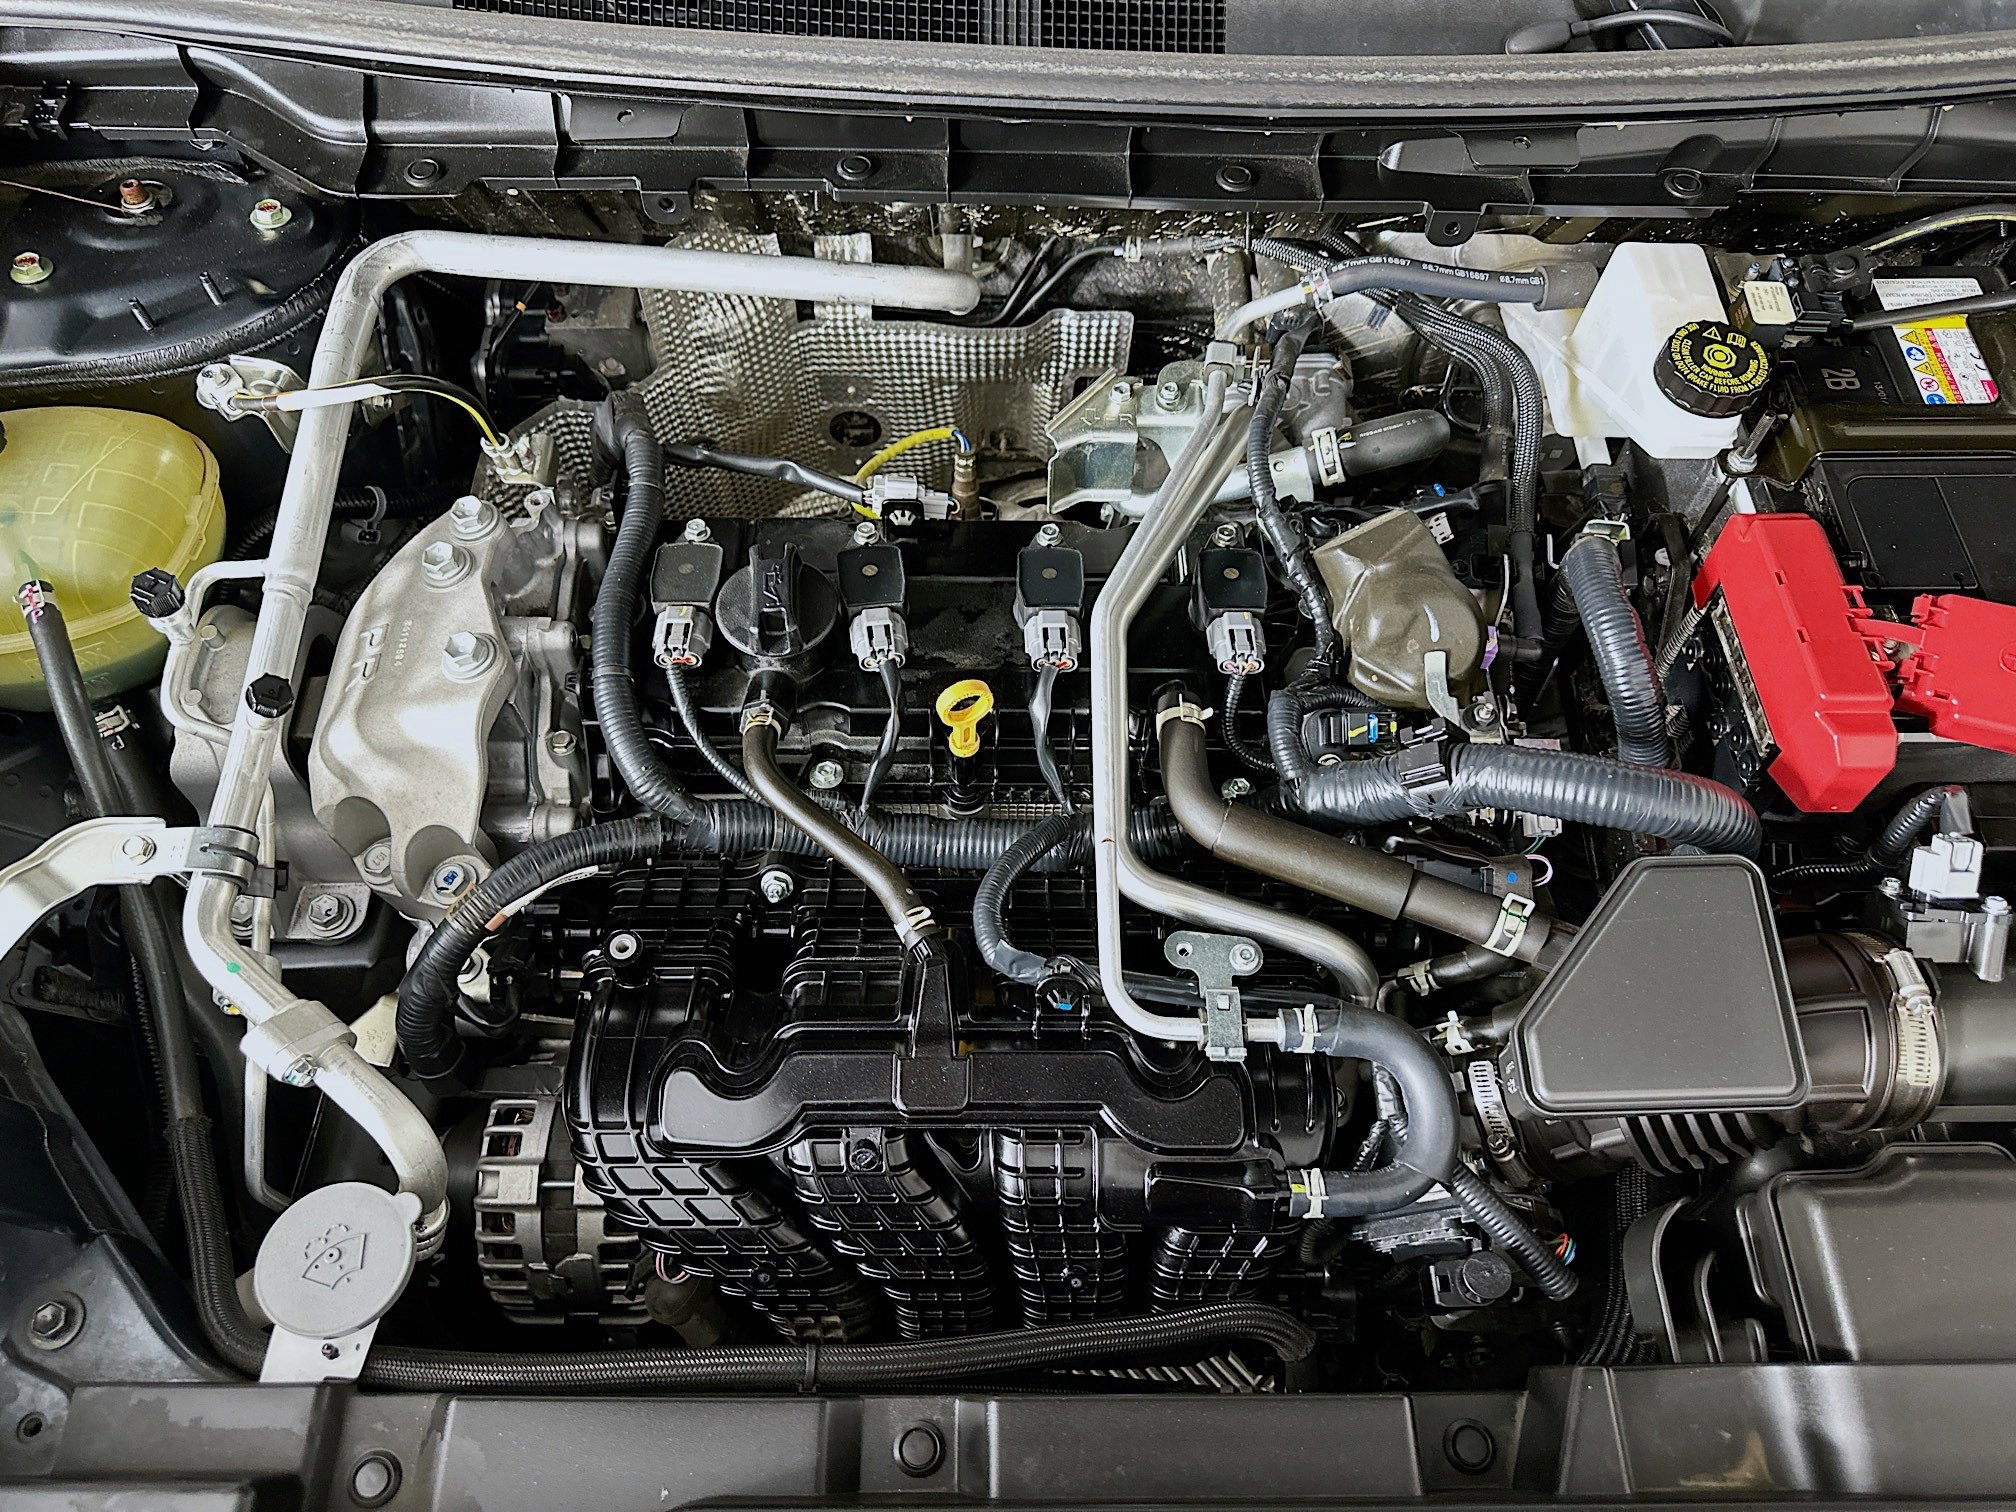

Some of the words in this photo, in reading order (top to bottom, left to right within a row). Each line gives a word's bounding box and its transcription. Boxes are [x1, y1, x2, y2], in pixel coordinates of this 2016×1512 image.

[1681, 339, 1692, 355] CLEAN
[1672, 353, 1681, 361] OR
[1750, 341, 1768, 369] CONTAINER
[1683, 356, 1701, 374] FILLER
[1701, 363, 1733, 378] WARNING
[1739, 359, 1758, 383] REMOVING
[1687, 373, 1709, 388] BRAKE
[1699, 371, 1713, 381] CAP
[1714, 377, 1741, 386] BEFORE
[1751, 369, 1768, 387] SEALED
[1821, 368, 1861, 390] 2B
[1709, 383, 1730, 394] FLUID
[1730, 384, 1750, 394] FROM
[1747, 382, 1754, 390] A
